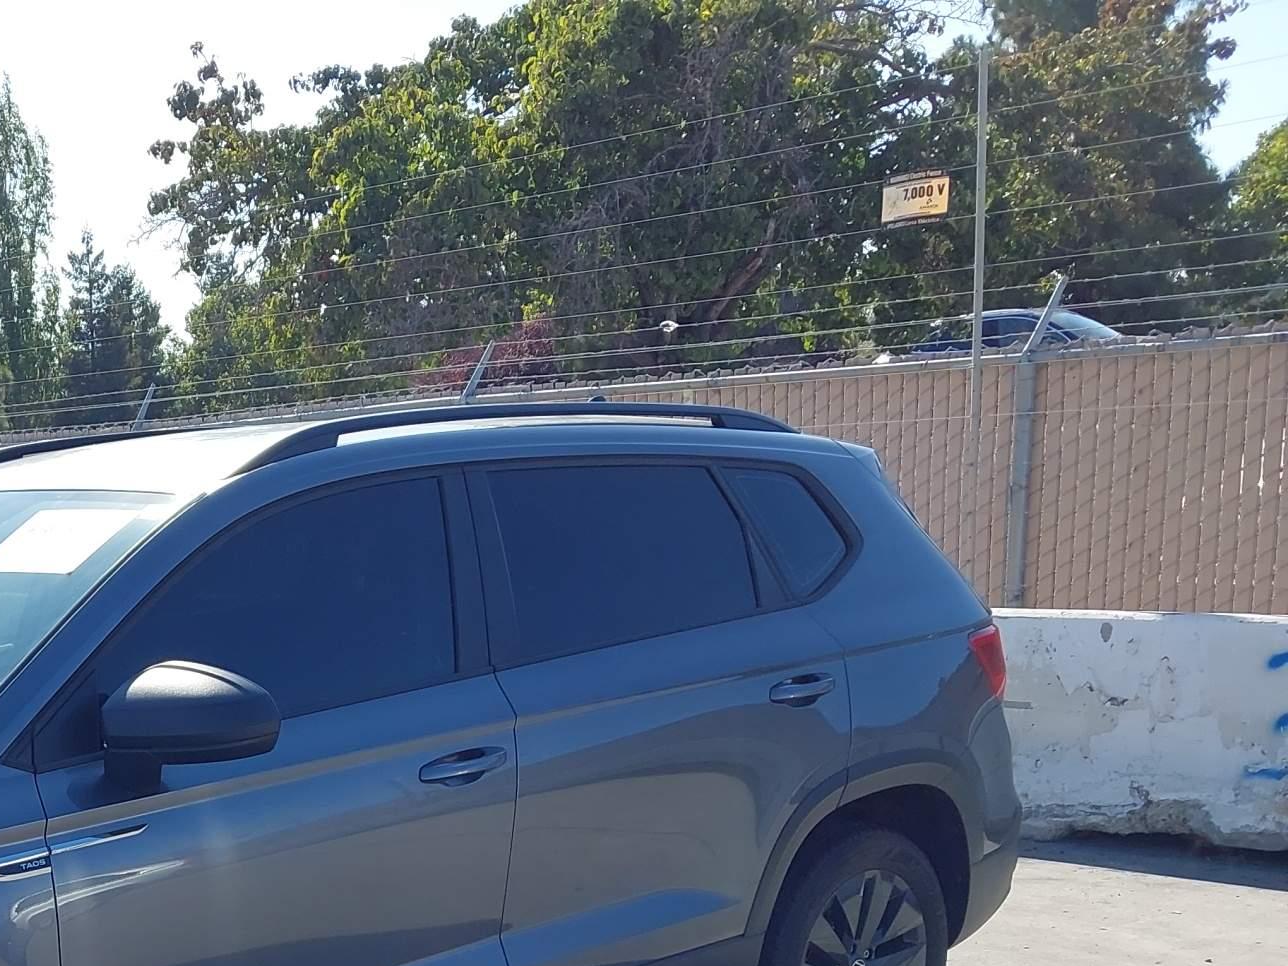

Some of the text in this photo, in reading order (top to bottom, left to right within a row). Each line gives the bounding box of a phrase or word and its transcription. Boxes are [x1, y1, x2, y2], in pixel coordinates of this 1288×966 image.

[903, 184, 945, 202] 7,000 V
[20, 858, 46, 870] TAOS
